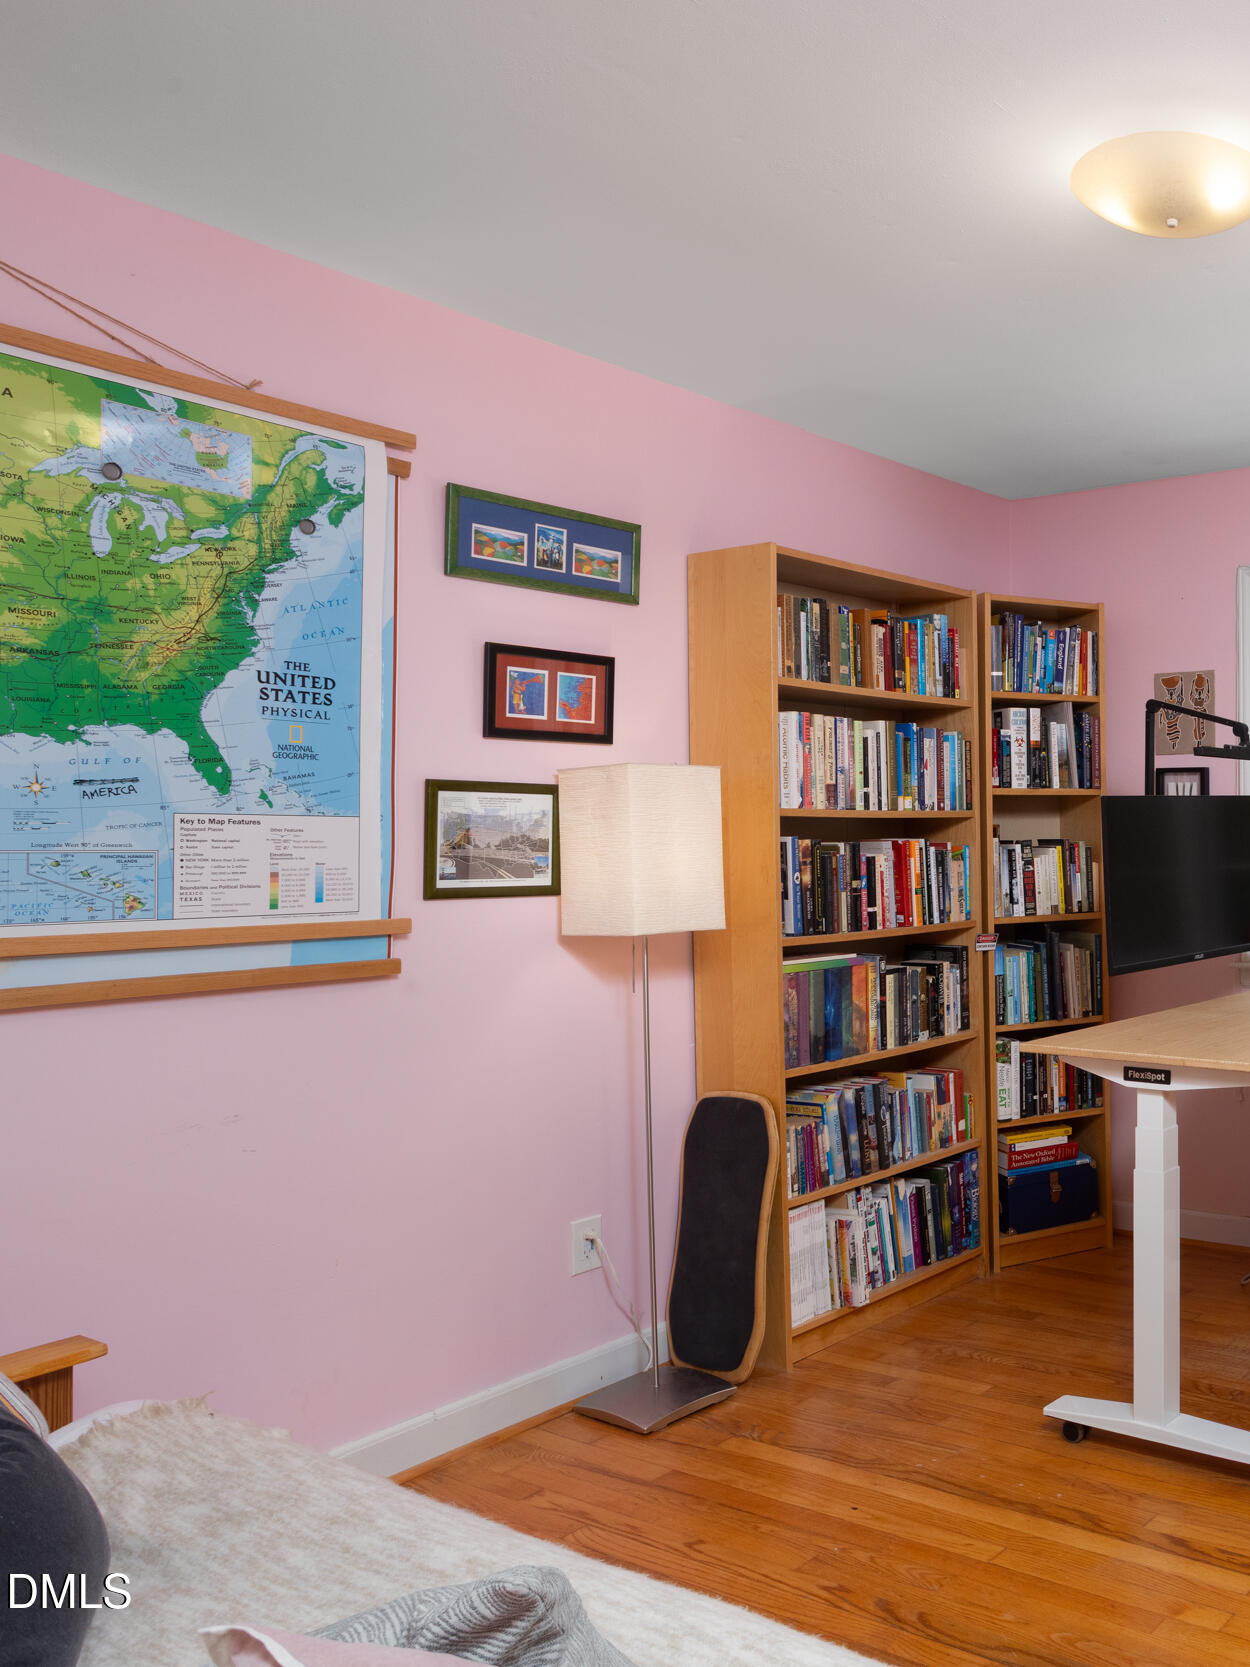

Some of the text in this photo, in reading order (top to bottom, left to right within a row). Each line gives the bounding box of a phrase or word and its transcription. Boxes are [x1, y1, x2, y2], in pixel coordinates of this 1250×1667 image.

[36, 506, 80, 518] WISCONSIN
[0, 535, 26, 544] IOWA
[64, 572, 97, 582] ILLINOIS
[101, 569, 133, 577] INDIANA
[8, 606, 57, 618] MISSOURI
[281, 598, 349, 617] ATLANTIC
[302, 626, 345, 641] OCEAN
[10, 646, 60, 656] ARKANSAS
[284, 660, 311, 673] THE
[256, 670, 337, 691] UNITED
[259, 687, 333, 707] STATES
[261, 705, 331, 721] PHYSICAL
[278, 744, 314, 753] NATIONAL
[68, 756, 142, 766] GULF OF
[272, 751, 319, 761] GEOGRAPHIC
[782, 727, 790, 790] Atomic Habits
[283, 772, 316, 781] BAHAMAS
[81, 784, 138, 801] AMERICA
[180, 818, 195, 826] Key
[208, 818, 226, 826] Map
[228, 818, 262, 826] Features
[1128, 1070, 1166, 1082] FlexiSpot
[998, 1088, 1007, 1108] EAT
[1035, 1148, 1056, 1157] Oxford
[1010, 1155, 1055, 1168] Annotated Bible
